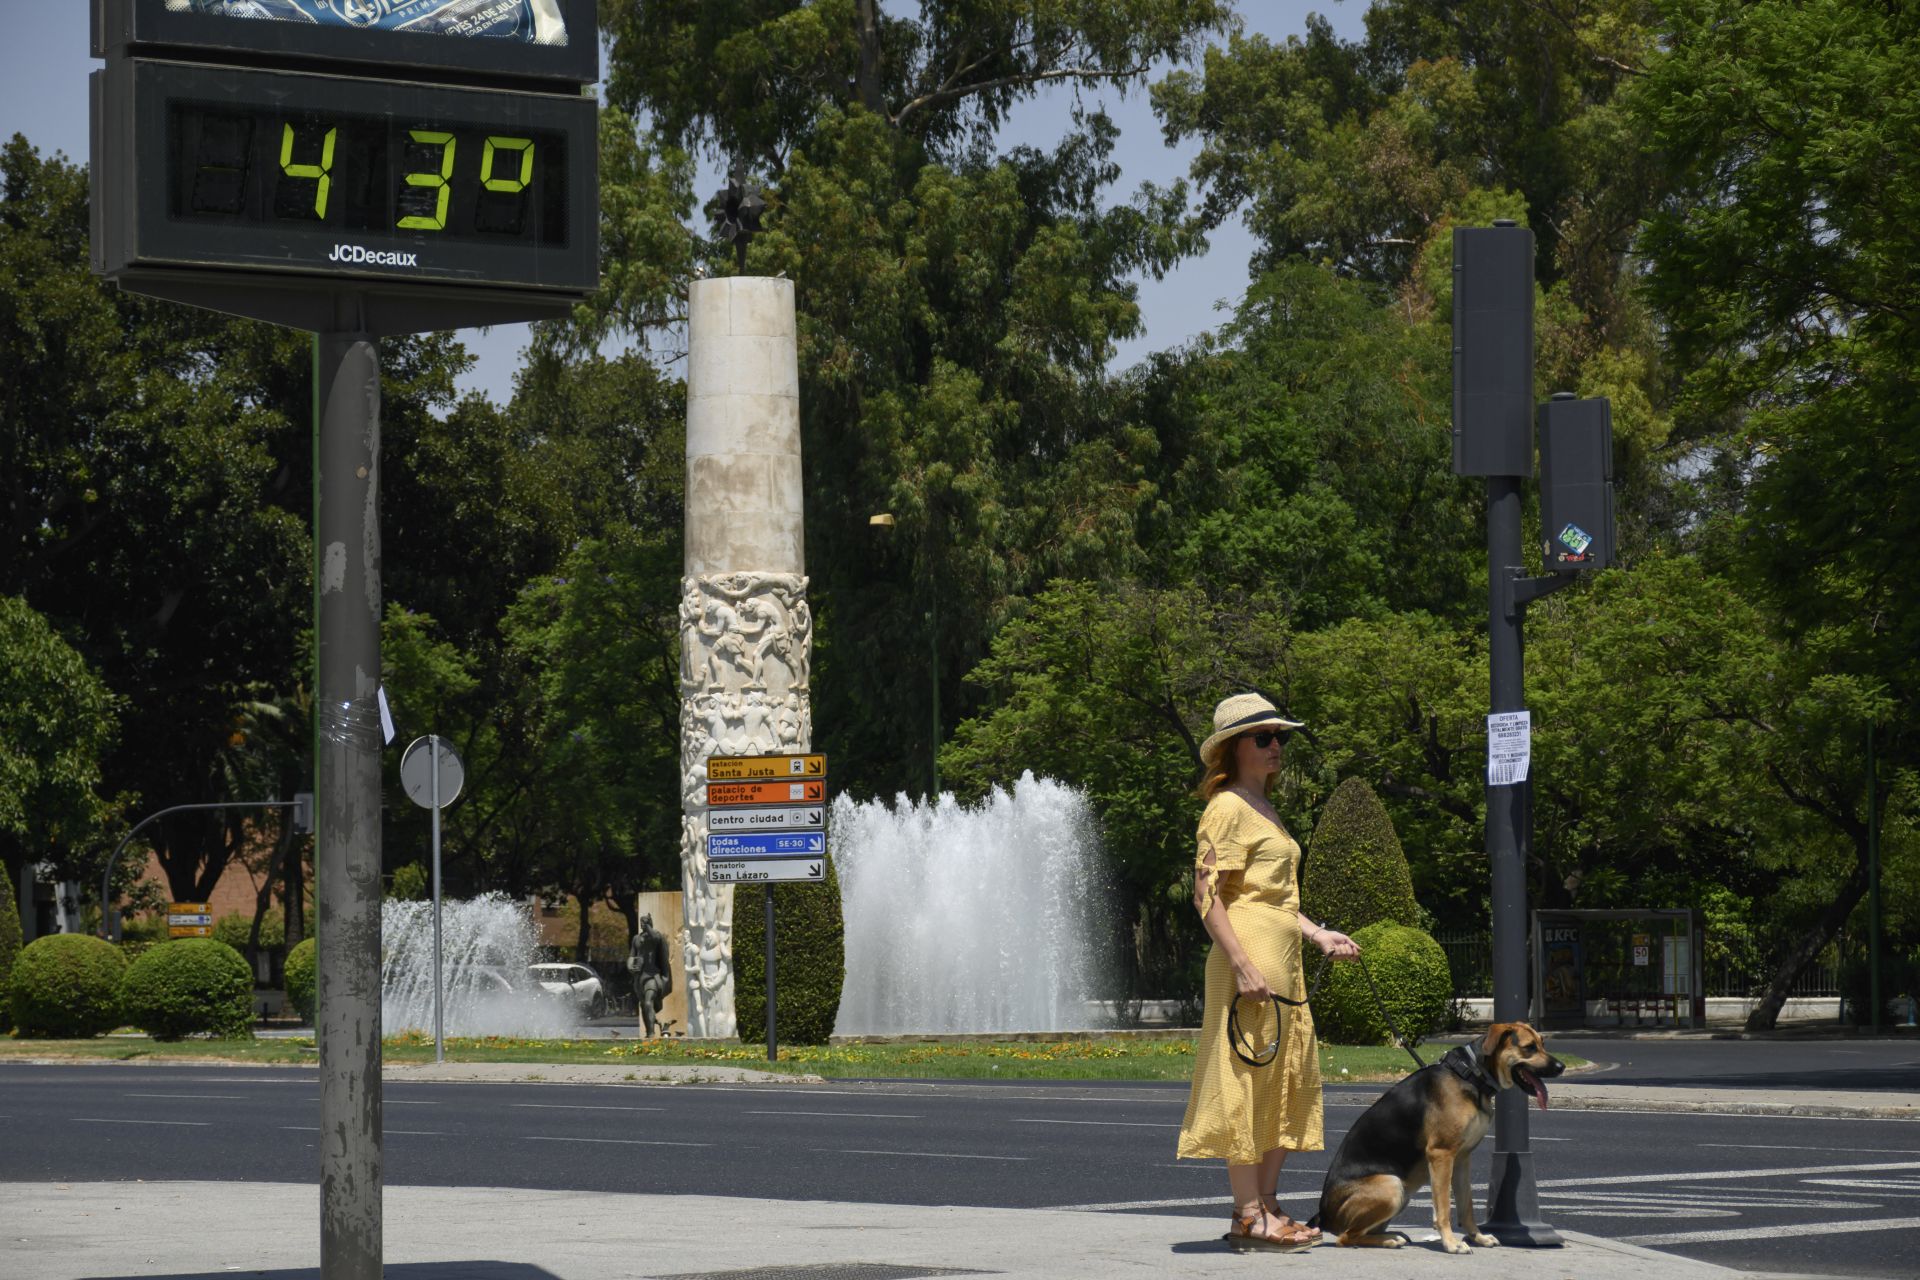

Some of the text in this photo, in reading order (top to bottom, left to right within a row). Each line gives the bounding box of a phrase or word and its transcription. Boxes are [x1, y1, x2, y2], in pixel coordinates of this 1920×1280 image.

[445, 20, 472, 36] EVES
[471, 12, 485, 24] 24
[483, 8, 498, 19] DE
[482, 21, 493, 29] EN
[329, 244, 417, 266] JCDecaux
[712, 768, 775, 777] Santa Justa
[712, 785, 762, 794] palacio de
[712, 793, 754, 802] deportes
[712, 814, 784, 824] centro ciudad
[712, 837, 739, 845] todas
[712, 844, 767, 854] direcciones
[737, 871, 769, 879] Lázaro
[1554, 928, 1578, 941] KFC
